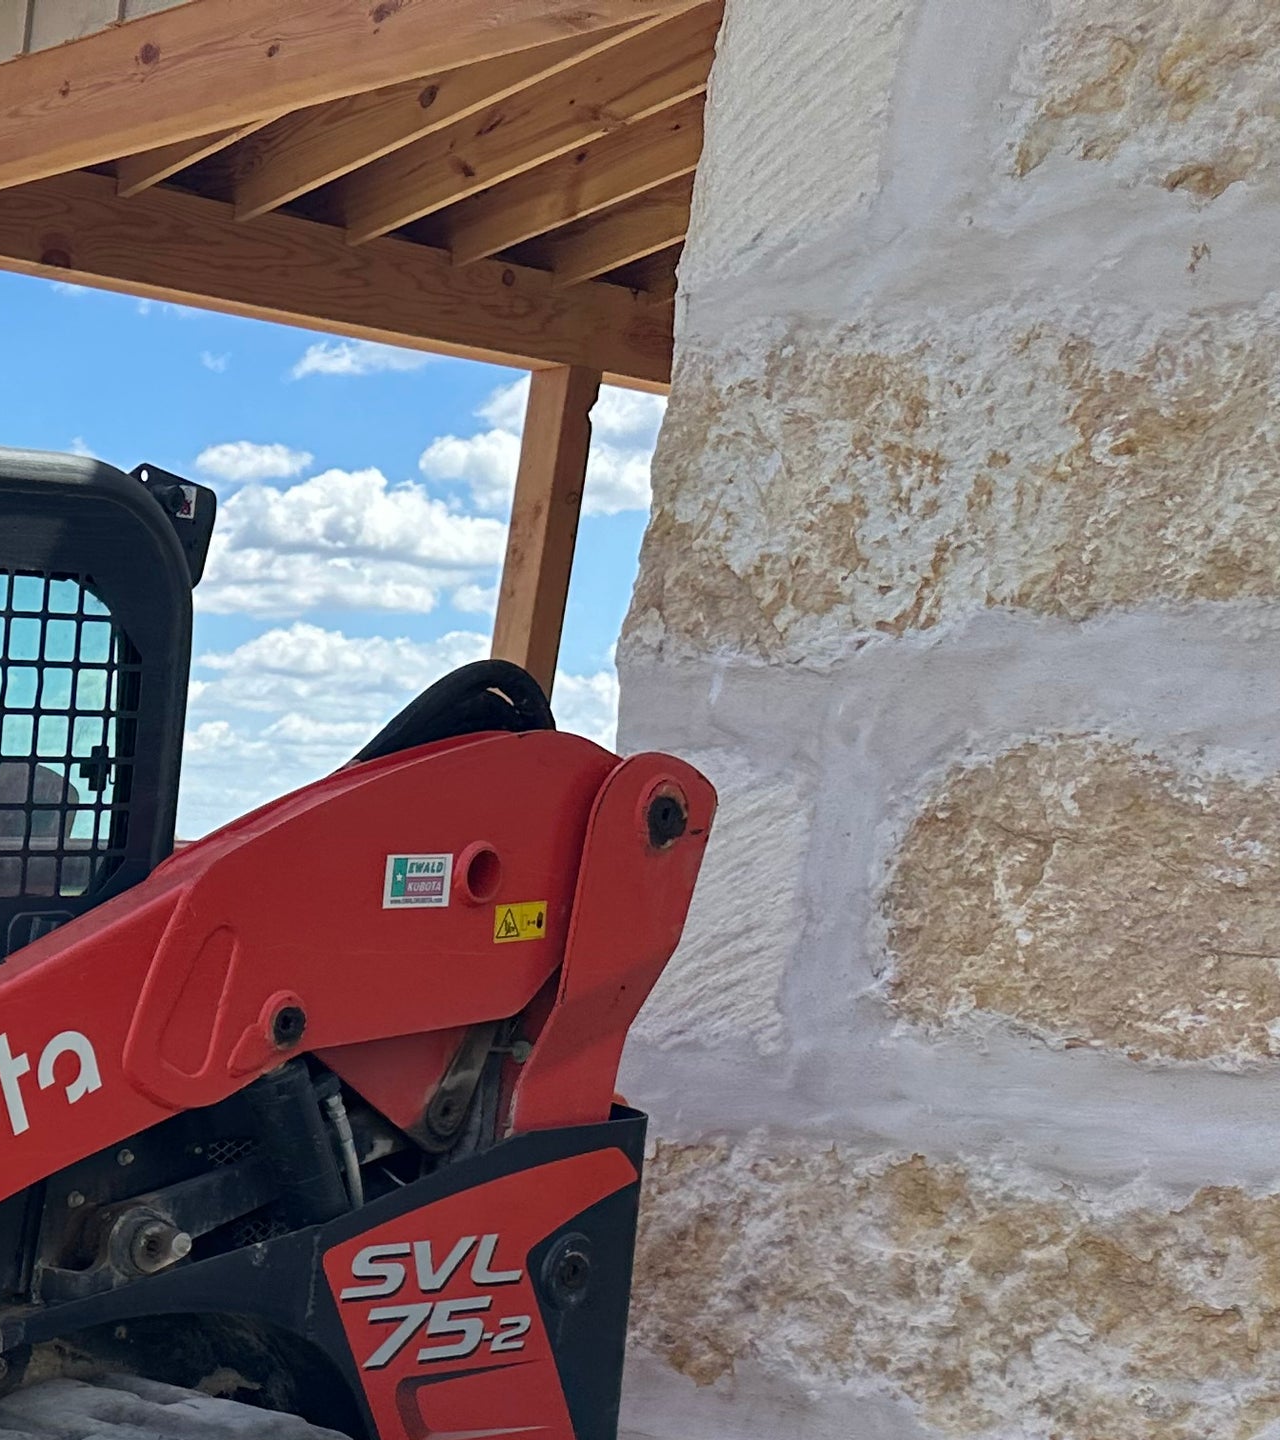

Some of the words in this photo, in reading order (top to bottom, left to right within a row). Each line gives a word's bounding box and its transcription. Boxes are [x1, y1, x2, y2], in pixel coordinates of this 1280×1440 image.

[406, 880, 441, 892] KUBOTA
[407, 861, 444, 874] EWALD
[340, 1233, 523, 1302] SVL
[362, 1295, 532, 1370] 75-2
